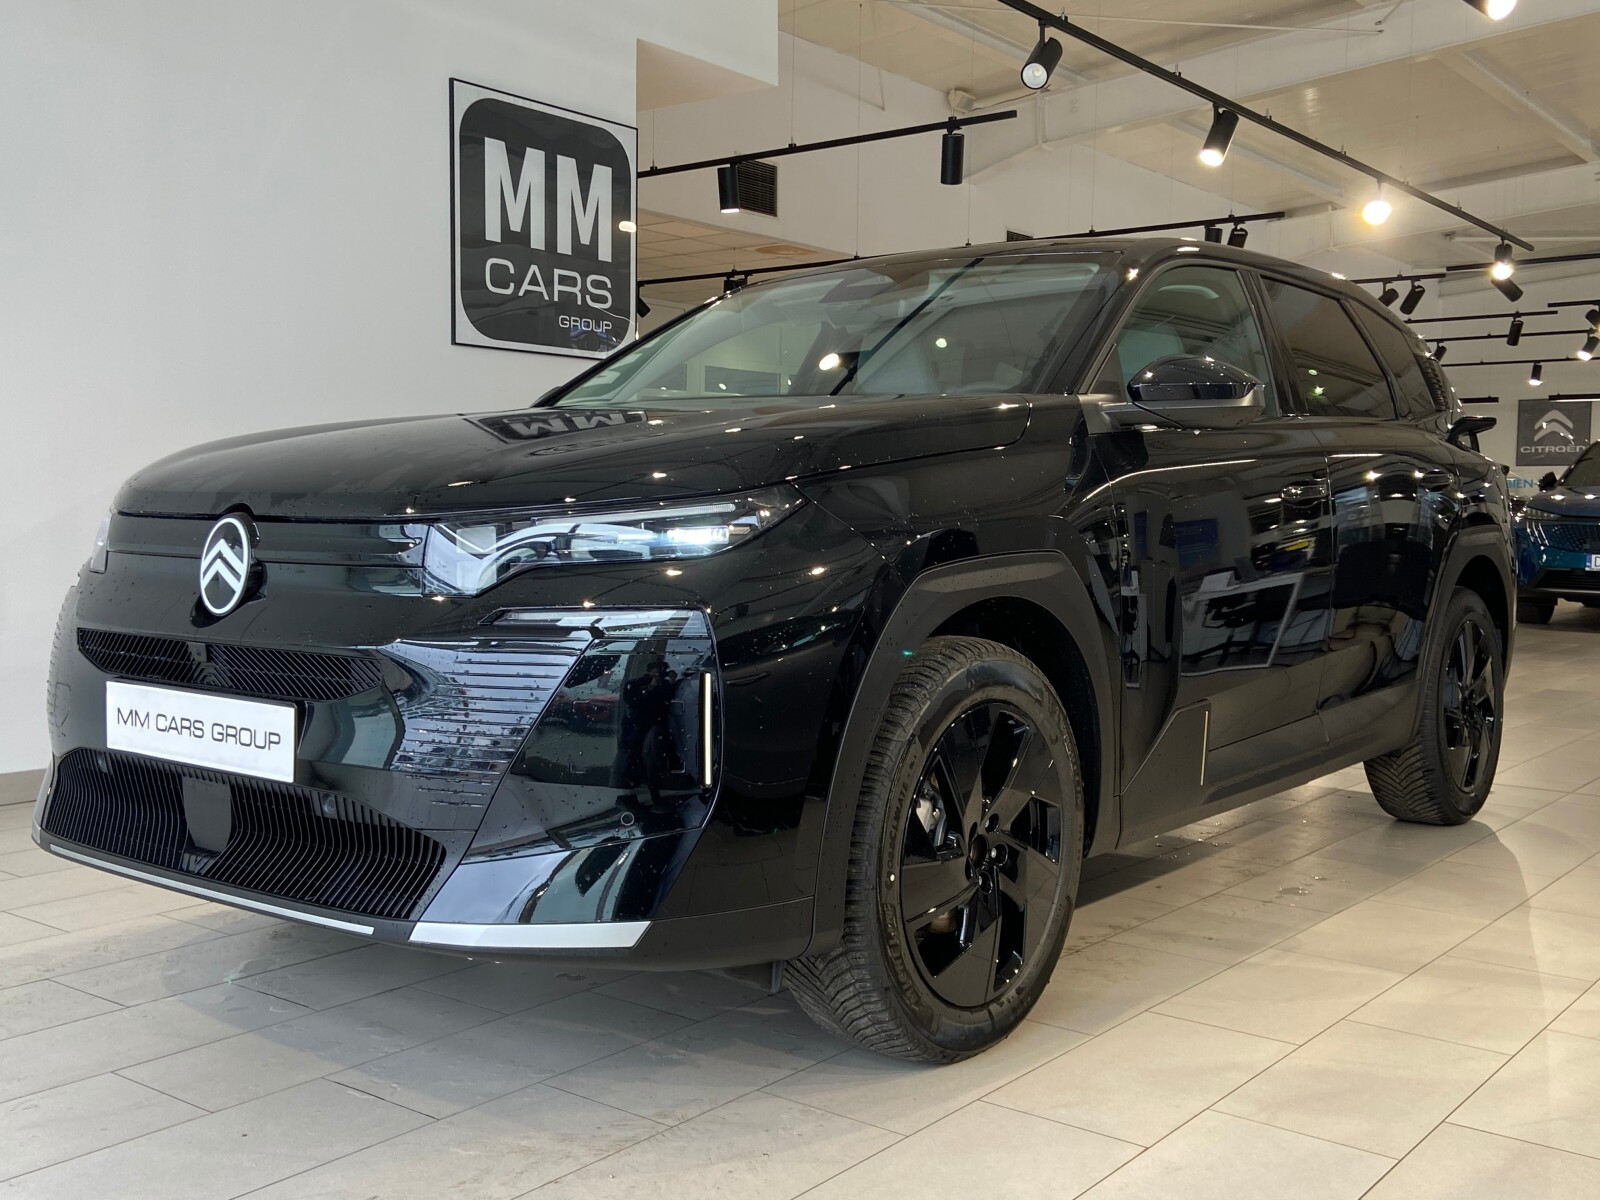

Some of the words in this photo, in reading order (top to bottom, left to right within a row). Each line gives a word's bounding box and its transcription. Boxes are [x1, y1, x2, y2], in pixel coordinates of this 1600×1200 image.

[484, 136, 612, 263] MM
[485, 257, 612, 309] CARS
[558, 315, 612, 333] GROUP
[117, 707, 150, 729] MM
[155, 713, 205, 739] CARS
[211, 722, 281, 750] GROUP
